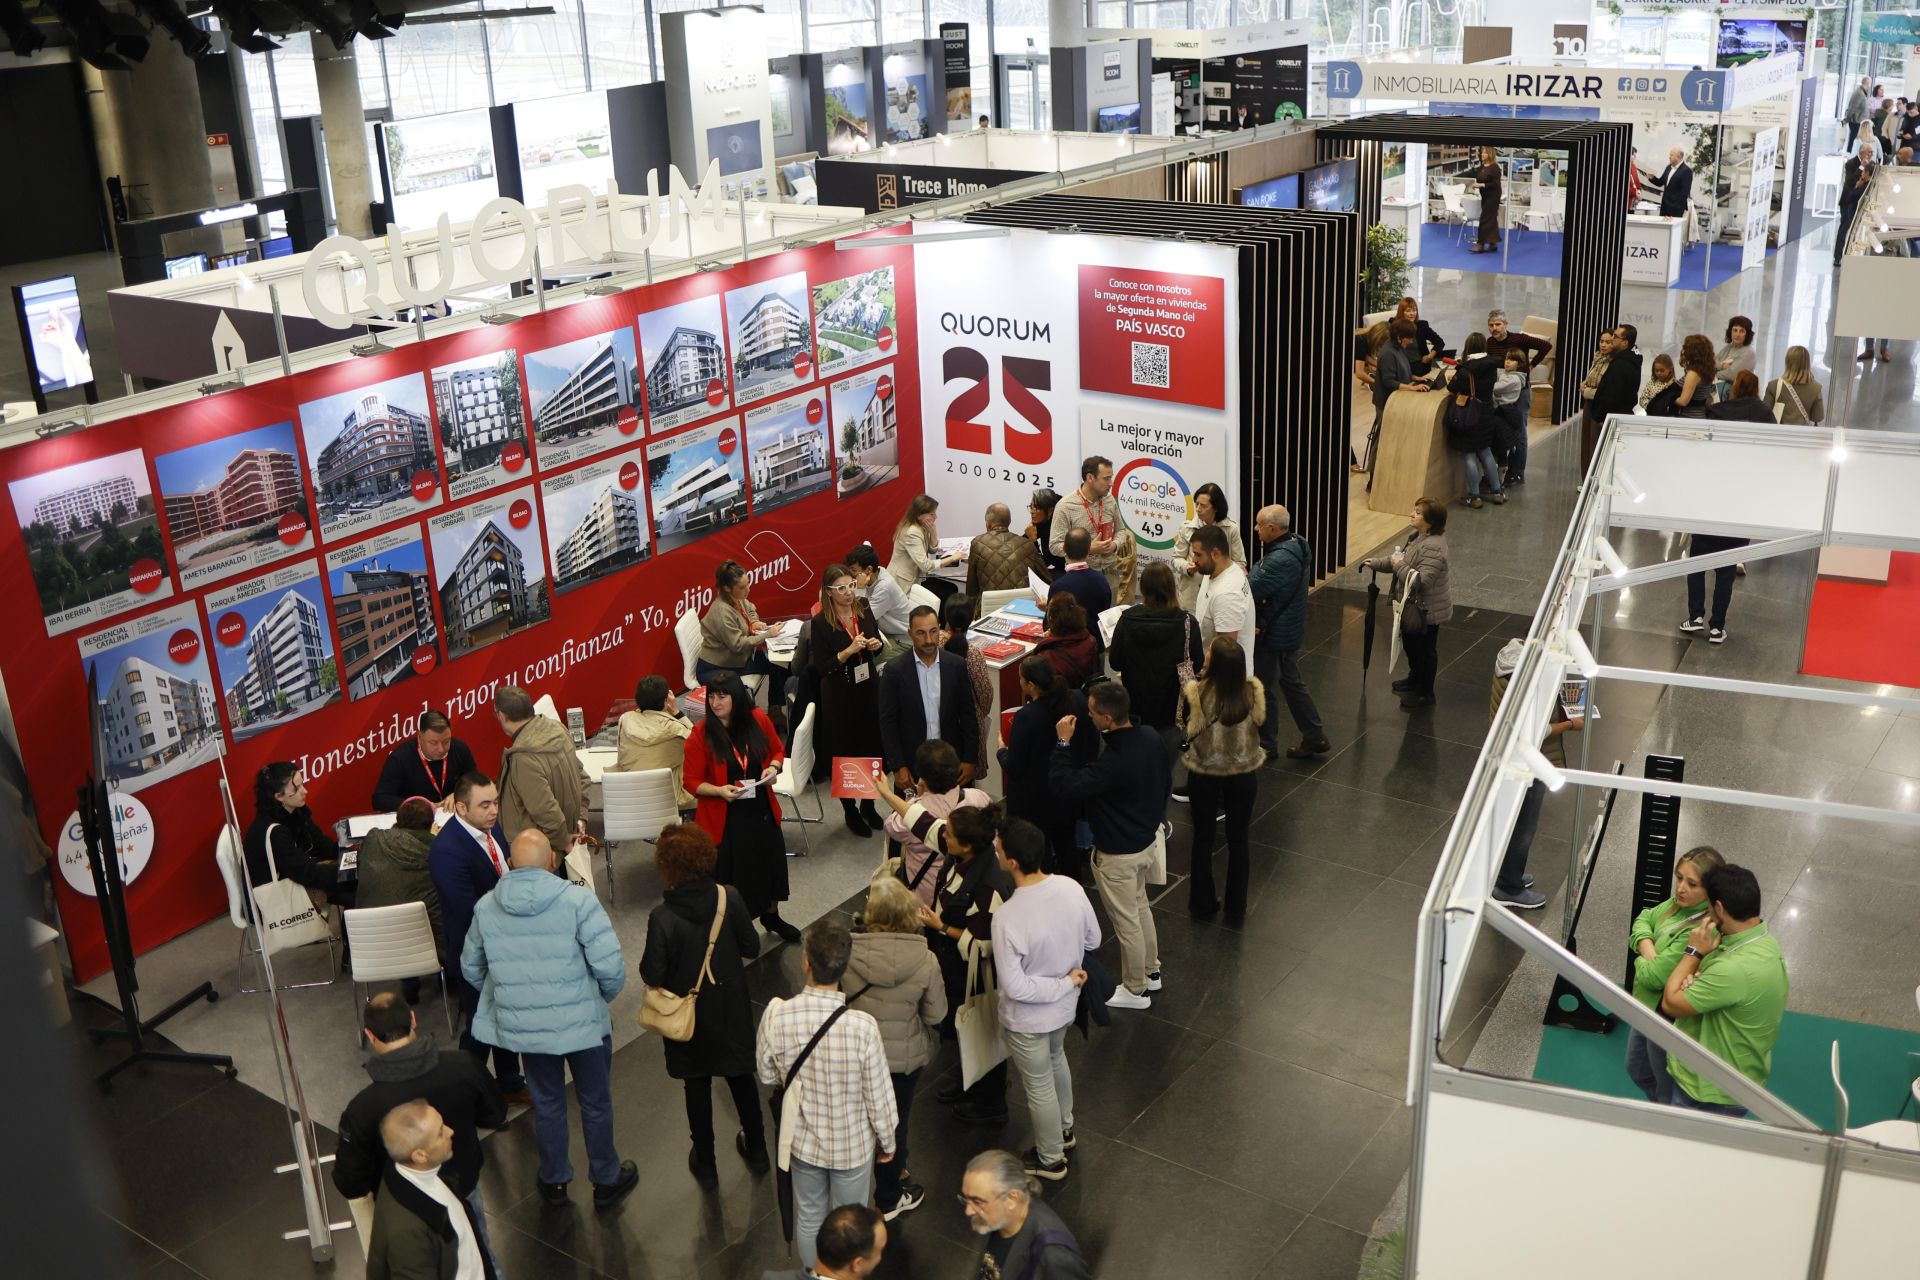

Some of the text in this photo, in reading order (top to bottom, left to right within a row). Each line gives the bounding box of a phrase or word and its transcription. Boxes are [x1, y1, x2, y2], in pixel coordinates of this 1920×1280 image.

[1373, 74, 1604, 99] INMOBILIARIA IRIZAR
[902, 175, 942, 195] Trece
[302, 157, 726, 331] QUORUM
[1625, 246, 1659, 259] IZAR
[1109, 278, 1192, 296] Conoce con nosotros
[1094, 289, 1207, 311] la mayor oferta en viviendas
[1106, 303, 1195, 322] de Segunda Mano del
[940, 311, 1051, 344] QUORUM
[1116, 318, 1185, 338] PAÍS VASCO
[739, 385, 765, 397] RESIDENCIAL
[942, 346, 1054, 465] 25
[1100, 418, 1205, 447] La mejor y mayor
[505, 452, 521, 462] BILBAO
[539, 449, 570, 463] RESIDENCIAL
[1121, 439, 1183, 458] valoración
[415, 480, 432, 491] BILBAO
[451, 475, 488, 492] APARTAHOTEL
[452, 487, 472, 498] SABINO
[472, 481, 491, 493] ARANA
[544, 474, 574, 488] RESIDENCIAL
[1127, 475, 1177, 498] Google
[1135, 496, 1148, 506] mil
[1150, 498, 1185, 514] Reseñas
[431, 510, 465, 525] RESIDENCIAL
[441, 516, 466, 529] URIBARRI
[512, 509, 528, 519] BILBAO
[277, 522, 307, 536] BARAKALDO
[323, 520, 348, 535] EDIFICIO
[348, 512, 373, 526] GARAGE
[1141, 521, 1164, 537] 4,9
[329, 544, 366, 561] RESIDENCIAL
[341, 549, 367, 564] BIARRITZ
[129, 568, 162, 585] BARAKALDO
[183, 555, 247, 582] AMETS BARAKALDO
[235, 578, 266, 593] MIRADOR
[210, 585, 267, 609] PARQUE AMEZOLA
[48, 615, 64, 626] IBAI
[64, 606, 92, 622] BERRIA
[83, 626, 128, 647] RESIDENCIAL
[221, 623, 241, 635] BILBAO
[96, 633, 130, 650] CATALINA
[169, 639, 198, 654] ORTUELLA
[416, 653, 433, 665] BILBAO
[445, 679, 499, 720] rigor
[640, 605, 669, 633] Yo,
[675, 585, 713, 618] elijo
[268, 922, 279, 930] EL
[280, 911, 313, 927] CORREO
